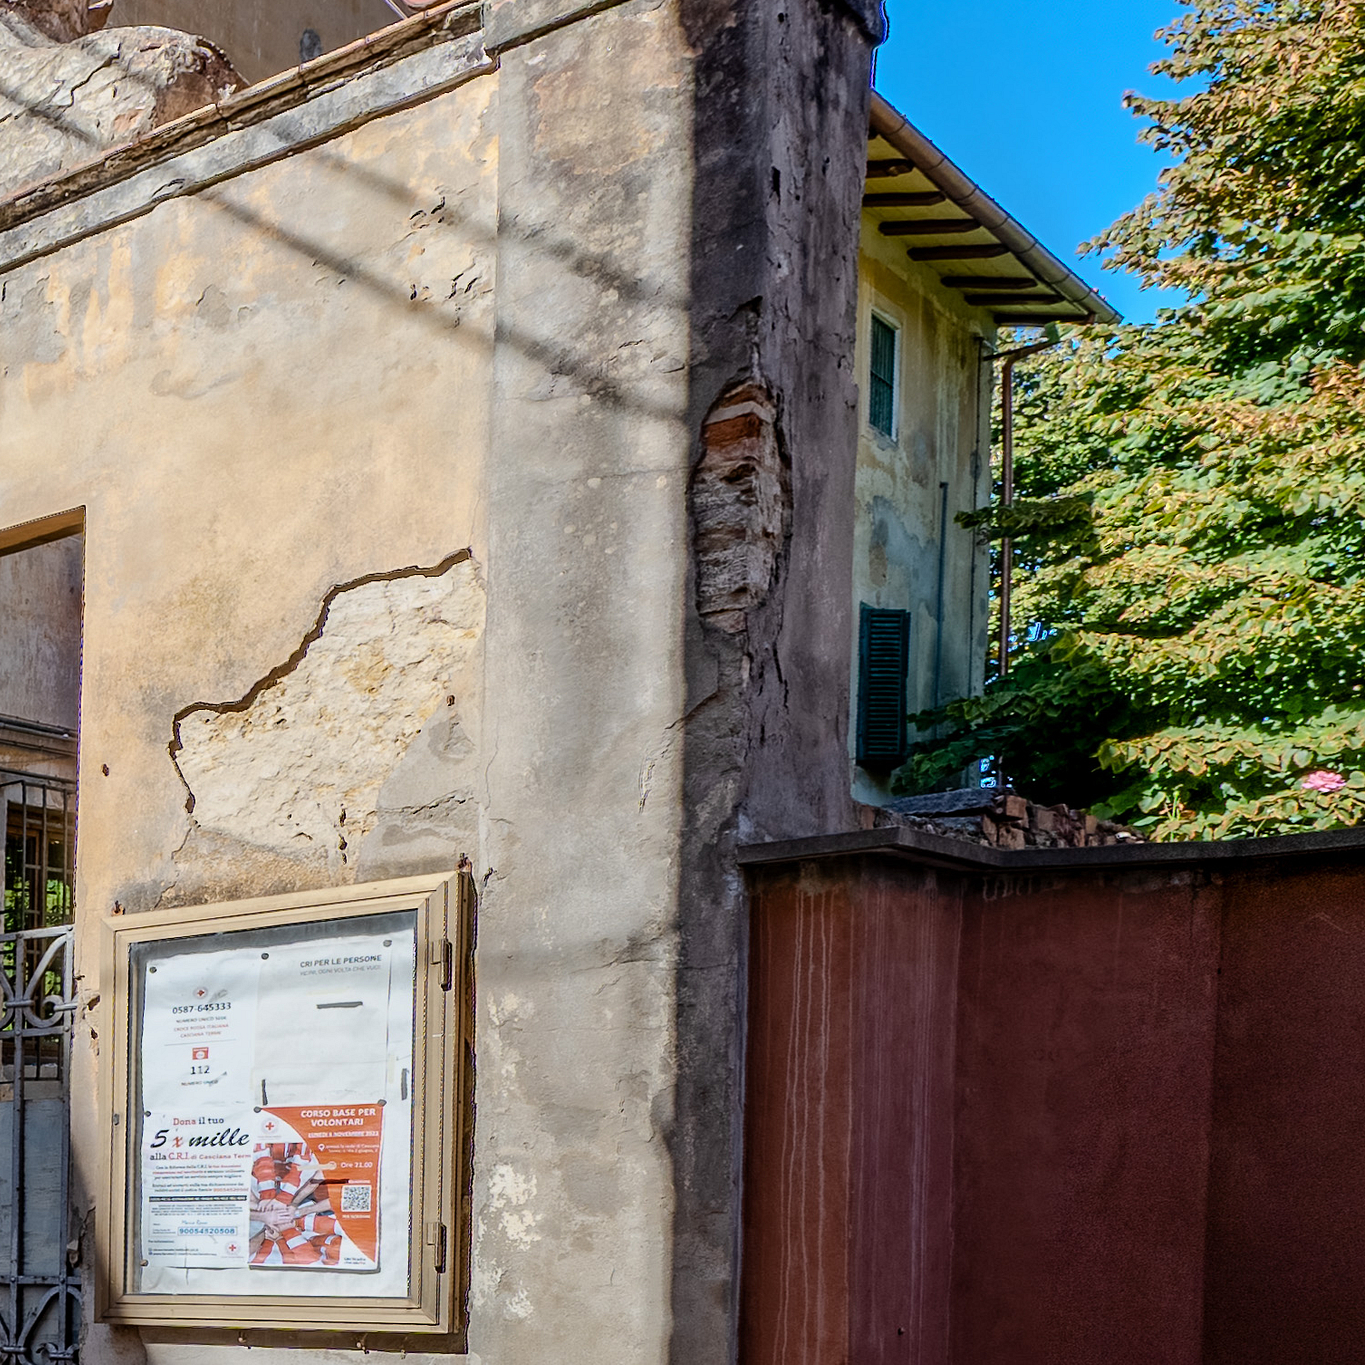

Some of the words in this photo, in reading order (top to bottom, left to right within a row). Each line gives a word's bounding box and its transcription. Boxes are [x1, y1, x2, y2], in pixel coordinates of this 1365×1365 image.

[314, 958, 330, 967] PER
[331, 957, 342, 965] LE
[343, 954, 382, 964] PERSONE
[172, 1001, 232, 1015] 0587-645333
[190, 1065, 210, 1075] 112
[301, 1110, 330, 1118] CORSO
[332, 1109, 355, 1117] BASE
[358, 1108, 376, 1116] PER
[173, 1118, 197, 1126] Dona
[198, 1117, 206, 1125] il
[207, 1117, 225, 1125] tuo
[311, 1118, 363, 1127] VOLONTARI
[150, 1129, 170, 1148] 5
[172, 1135, 184, 1148] x
[188, 1127, 250, 1148] mille
